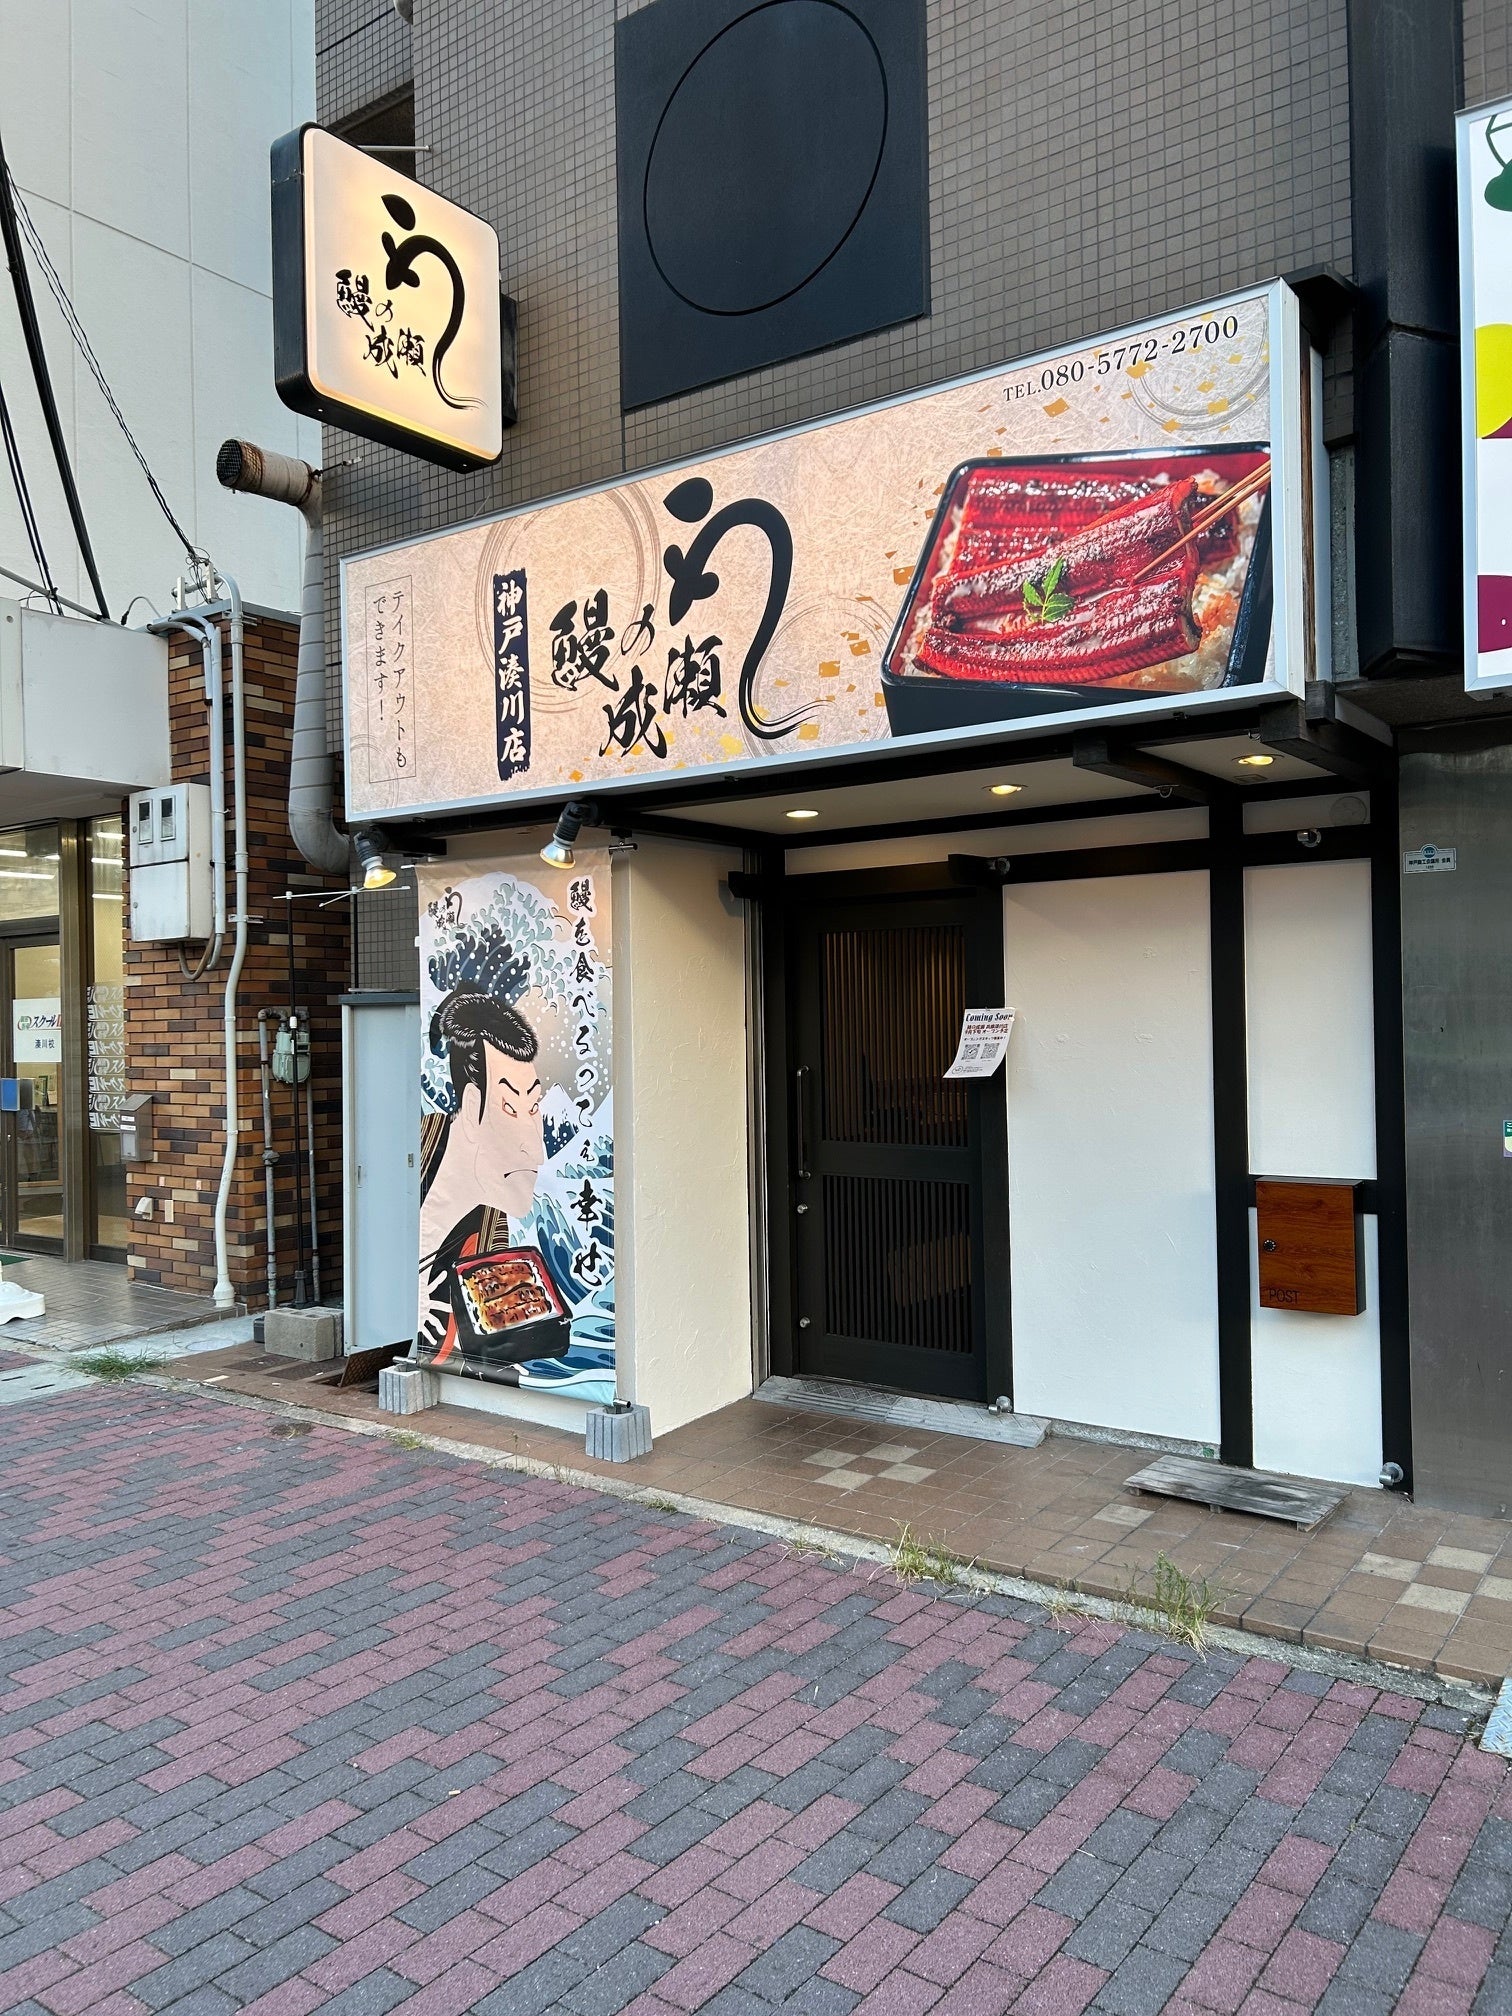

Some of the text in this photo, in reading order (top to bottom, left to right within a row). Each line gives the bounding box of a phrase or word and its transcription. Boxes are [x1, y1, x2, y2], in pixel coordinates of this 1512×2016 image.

[1002, 315, 1239, 402] TEL.080-5772-2700
[391, 591, 407, 767] テイクアウトも
[496, 579, 527, 763] 神戸湊川店
[966, 1013, 993, 1022] Coming
[1268, 1288, 1300, 1303] POST
